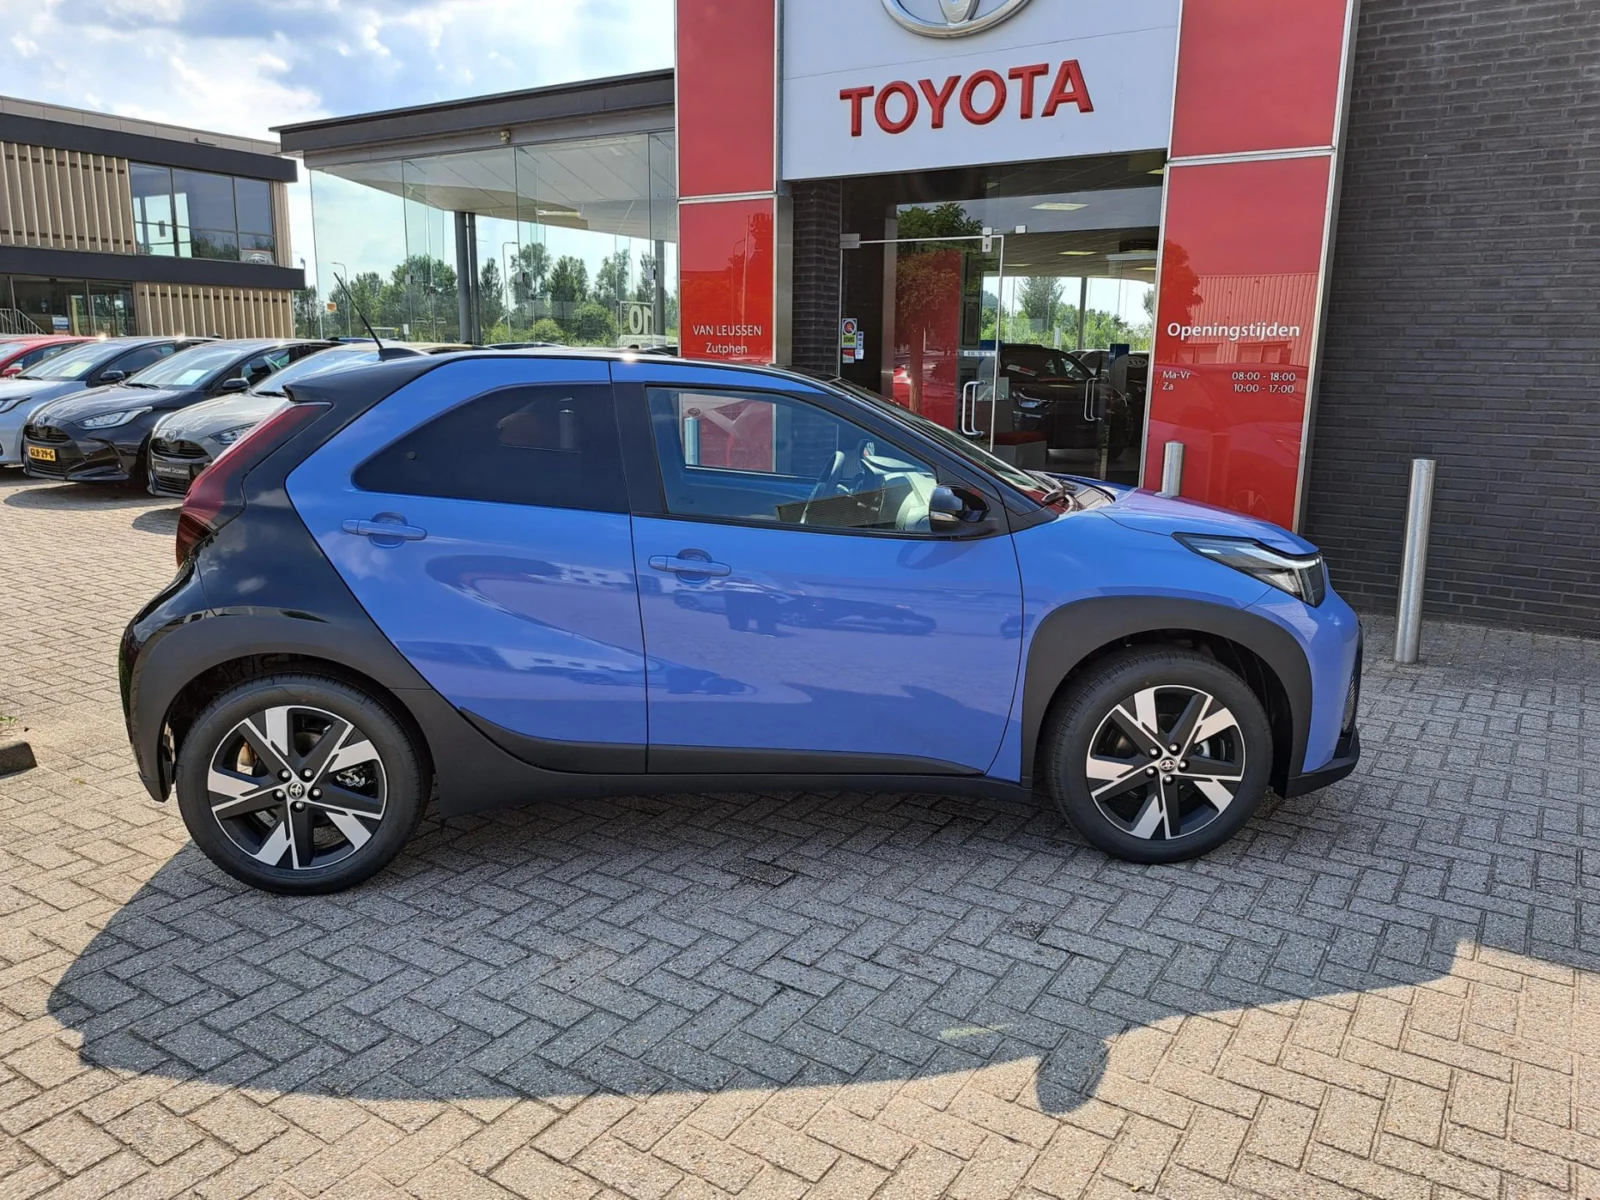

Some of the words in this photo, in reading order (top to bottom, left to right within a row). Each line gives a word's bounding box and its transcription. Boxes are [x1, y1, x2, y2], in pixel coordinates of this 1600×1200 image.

[839, 59, 1095, 137] TOYOTA
[692, 324, 714, 336] VAN
[716, 324, 762, 336] LEUSSEN
[1167, 322, 1300, 341] Openingstijden
[706, 342, 748, 356] Zutphen
[1162, 370, 1192, 380] Ma-Vr
[1231, 371, 1261, 382] 08:00
[1269, 372, 1297, 382] 18:00
[1162, 382, 1175, 391] Za
[1233, 383, 1260, 393] 10:00
[1268, 384, 1295, 394] 17:00
